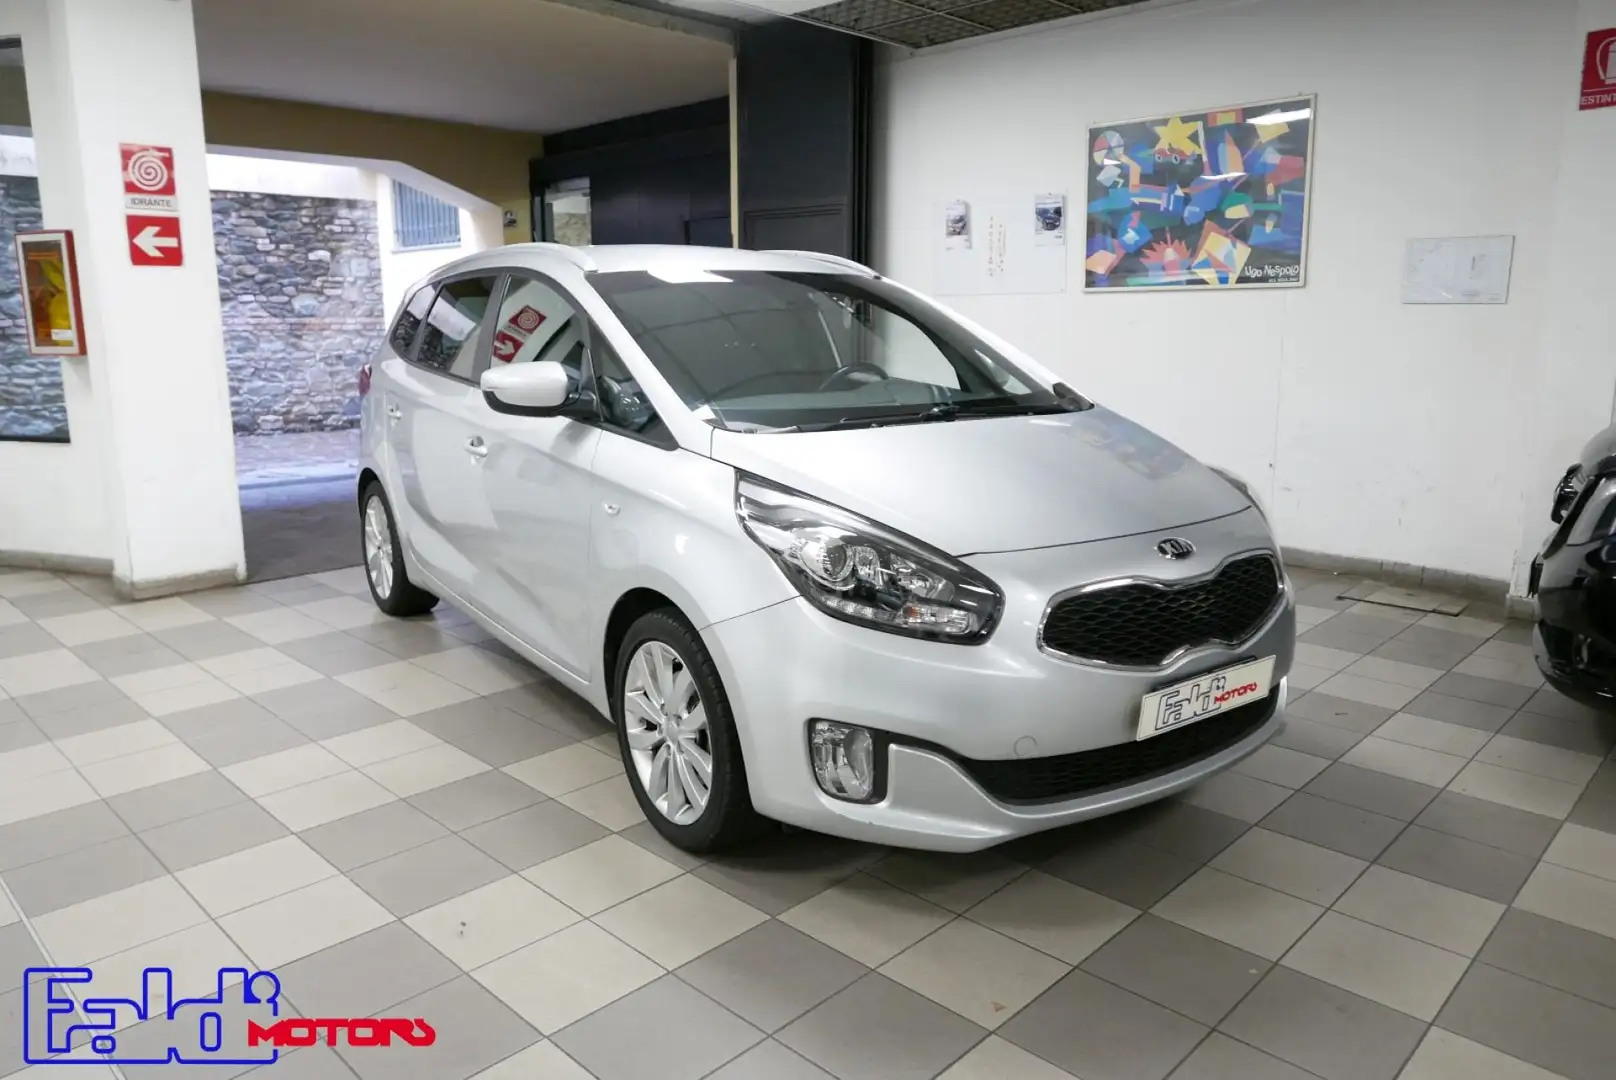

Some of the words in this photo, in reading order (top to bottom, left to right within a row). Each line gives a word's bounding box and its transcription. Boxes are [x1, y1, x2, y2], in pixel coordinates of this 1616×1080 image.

[130, 197, 172, 207] IDRANTE
[1244, 265, 1263, 278] Ugo
[1159, 540, 1193, 557] KIA
